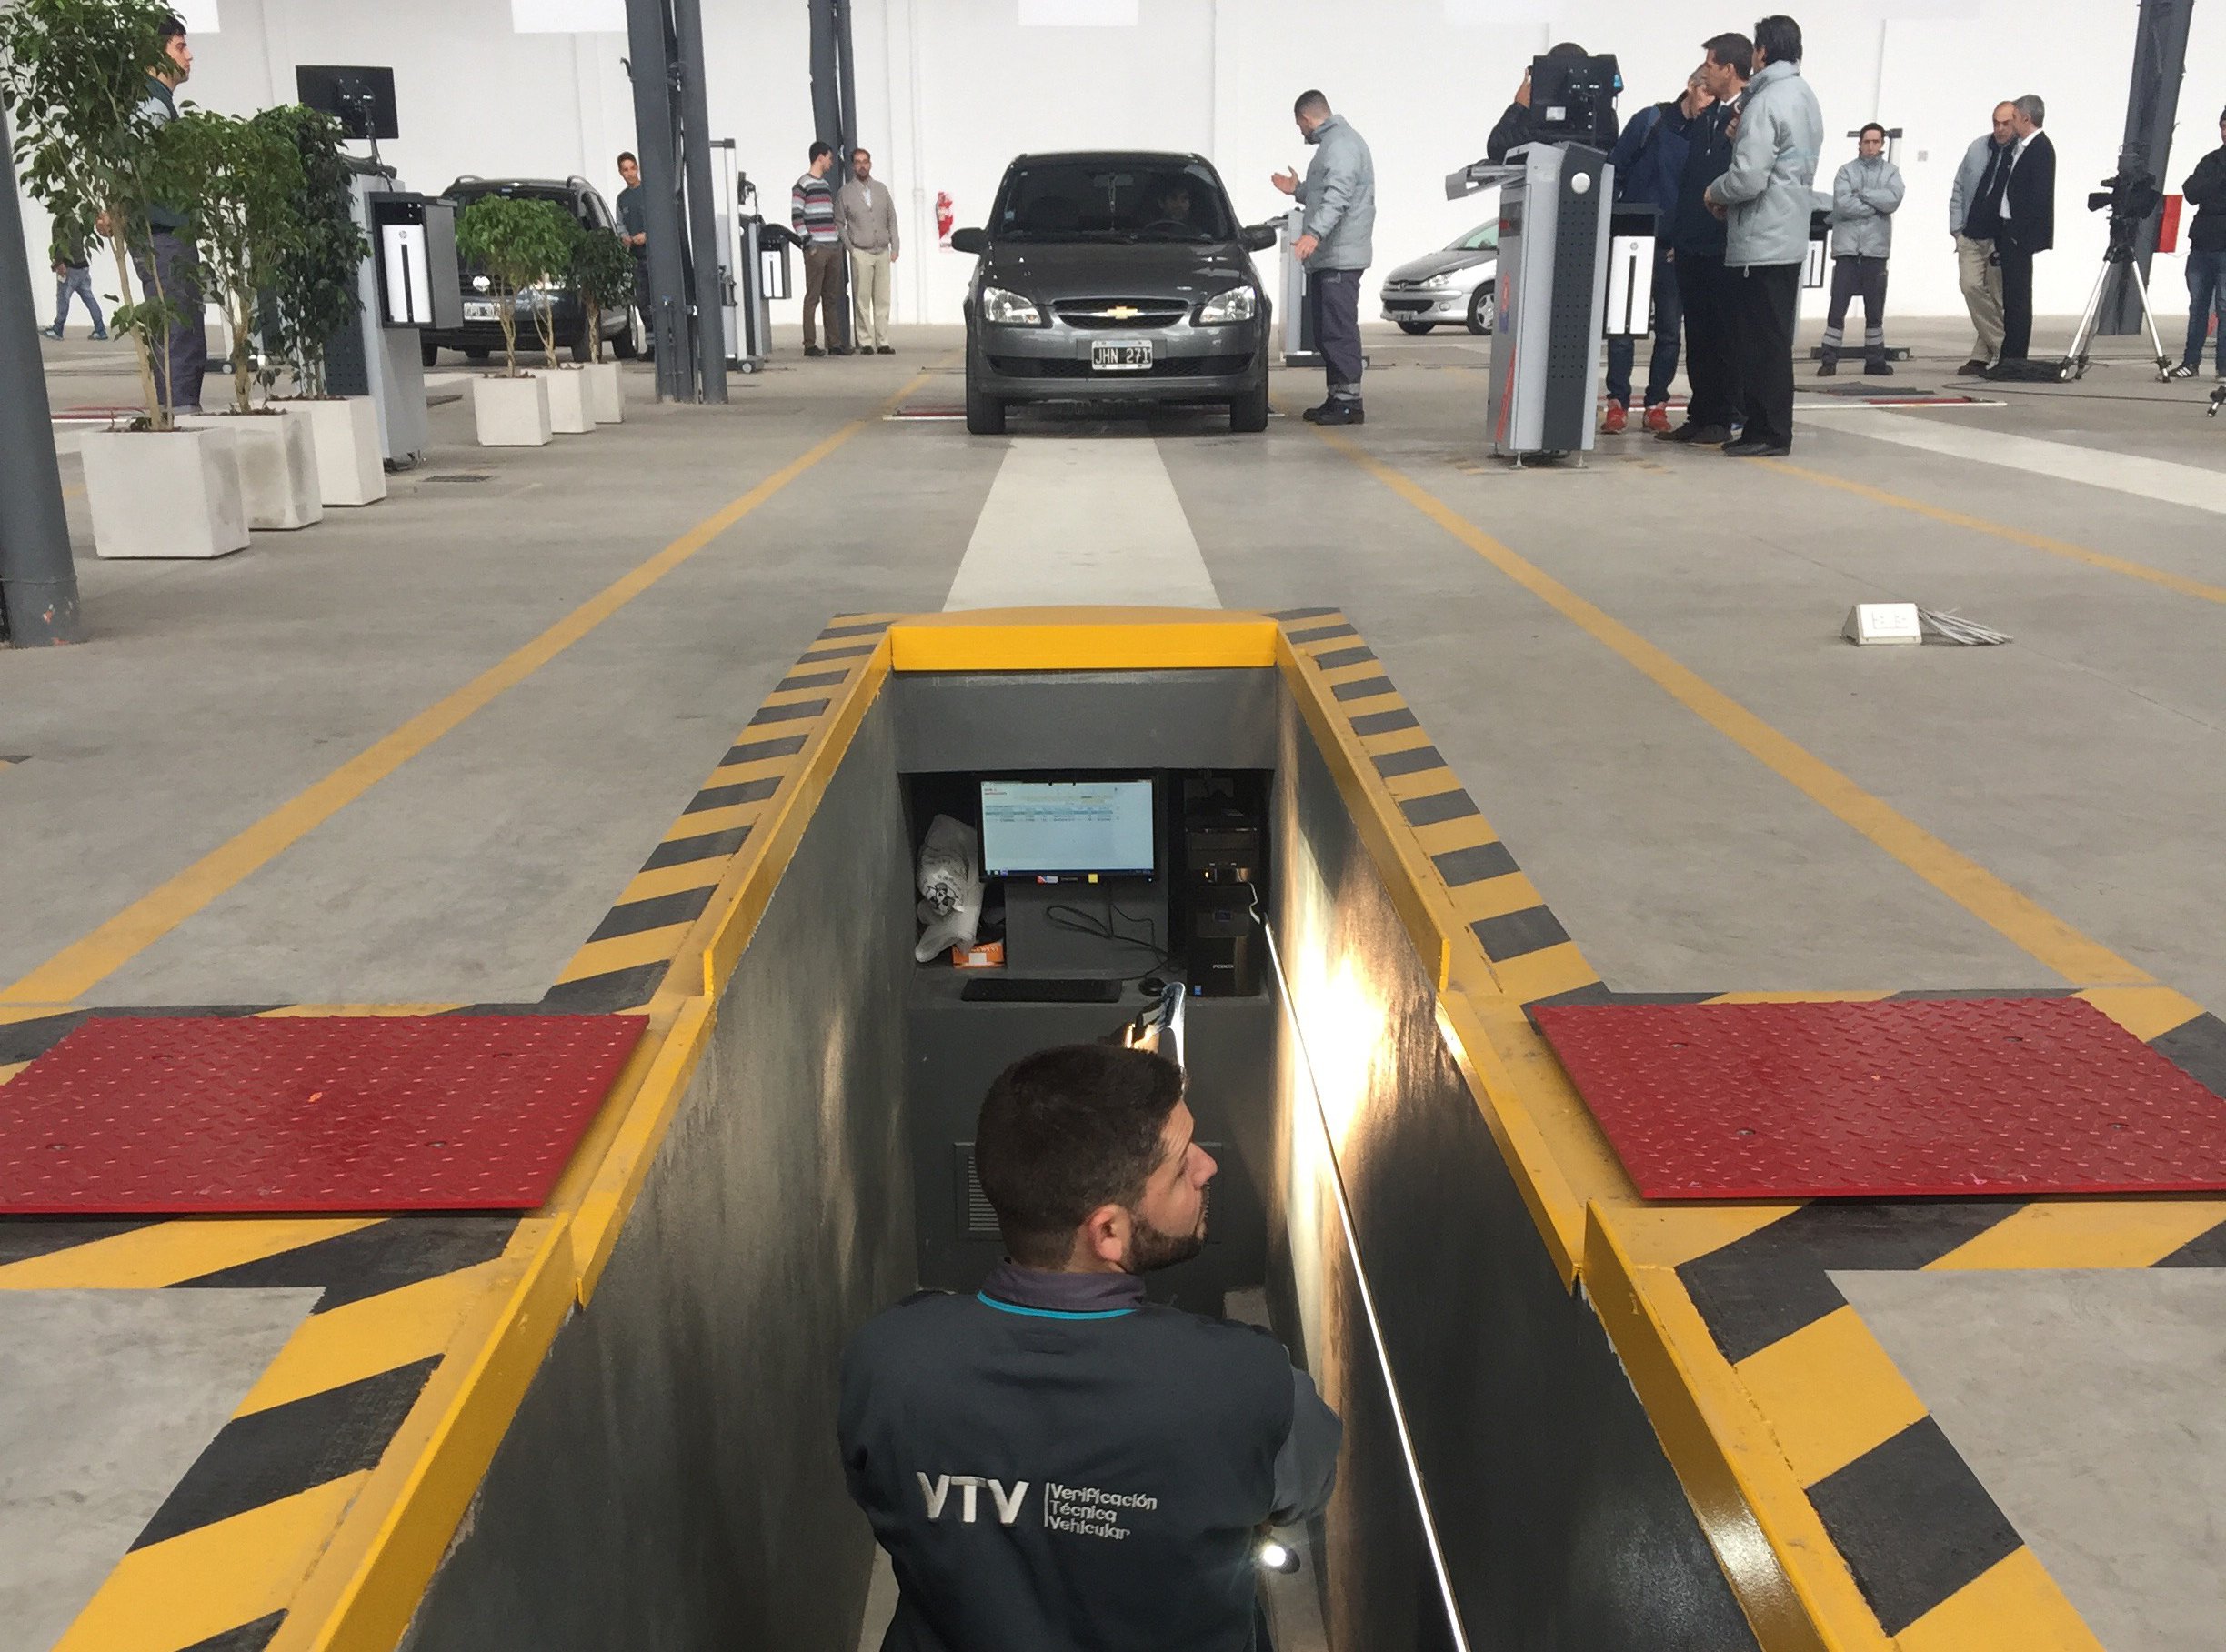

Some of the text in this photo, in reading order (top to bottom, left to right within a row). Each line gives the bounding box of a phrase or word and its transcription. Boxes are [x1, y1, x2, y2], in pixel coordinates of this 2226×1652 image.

[1095, 347, 1149, 364] JHN 271
[916, 1471, 1030, 1525] VTV
[1050, 1483, 1158, 1510] Verificación
[1050, 1500, 1118, 1522] Técnica
[1048, 1516, 1131, 1540] Vehicular
